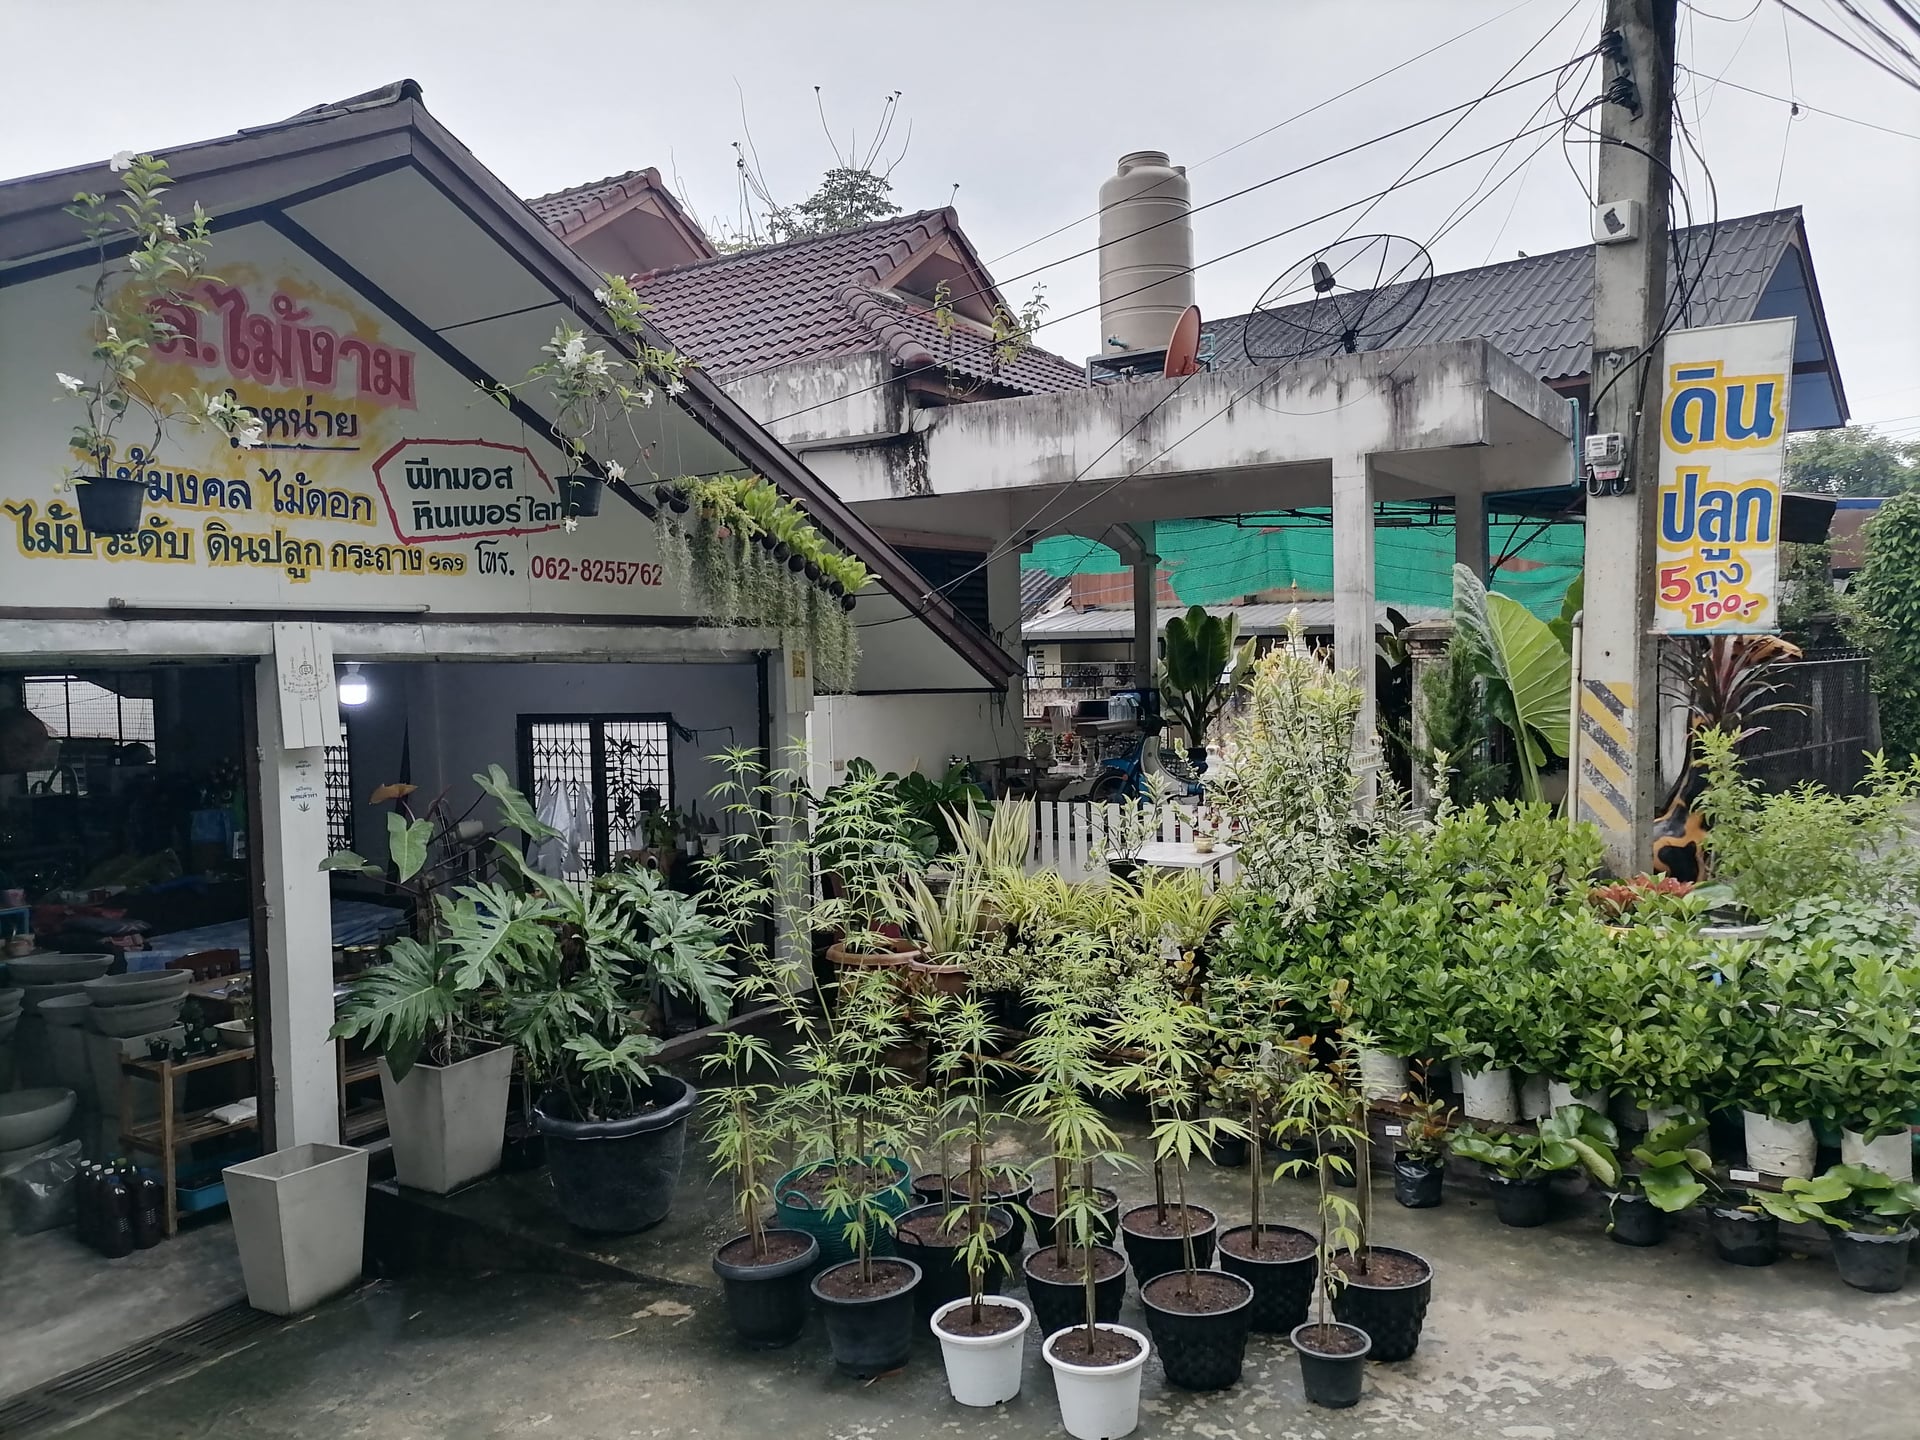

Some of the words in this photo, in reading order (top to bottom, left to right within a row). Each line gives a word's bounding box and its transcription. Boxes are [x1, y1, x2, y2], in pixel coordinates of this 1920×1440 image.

[1670, 368, 1775, 443] ดิน
[260, 468, 372, 520] ไม้ดอก
[1663, 473, 1772, 561] ปลูก
[207, 522, 321, 579] ดินปลูก
[332, 542, 421, 571] กระถาง
[429, 556, 464, 571] ฯลฯ
[475, 540, 515, 576] โทร.
[531, 555, 664, 586] 062-8255762
[1661, 566, 1691, 602] 5
[1695, 563, 1744, 598] ถุง
